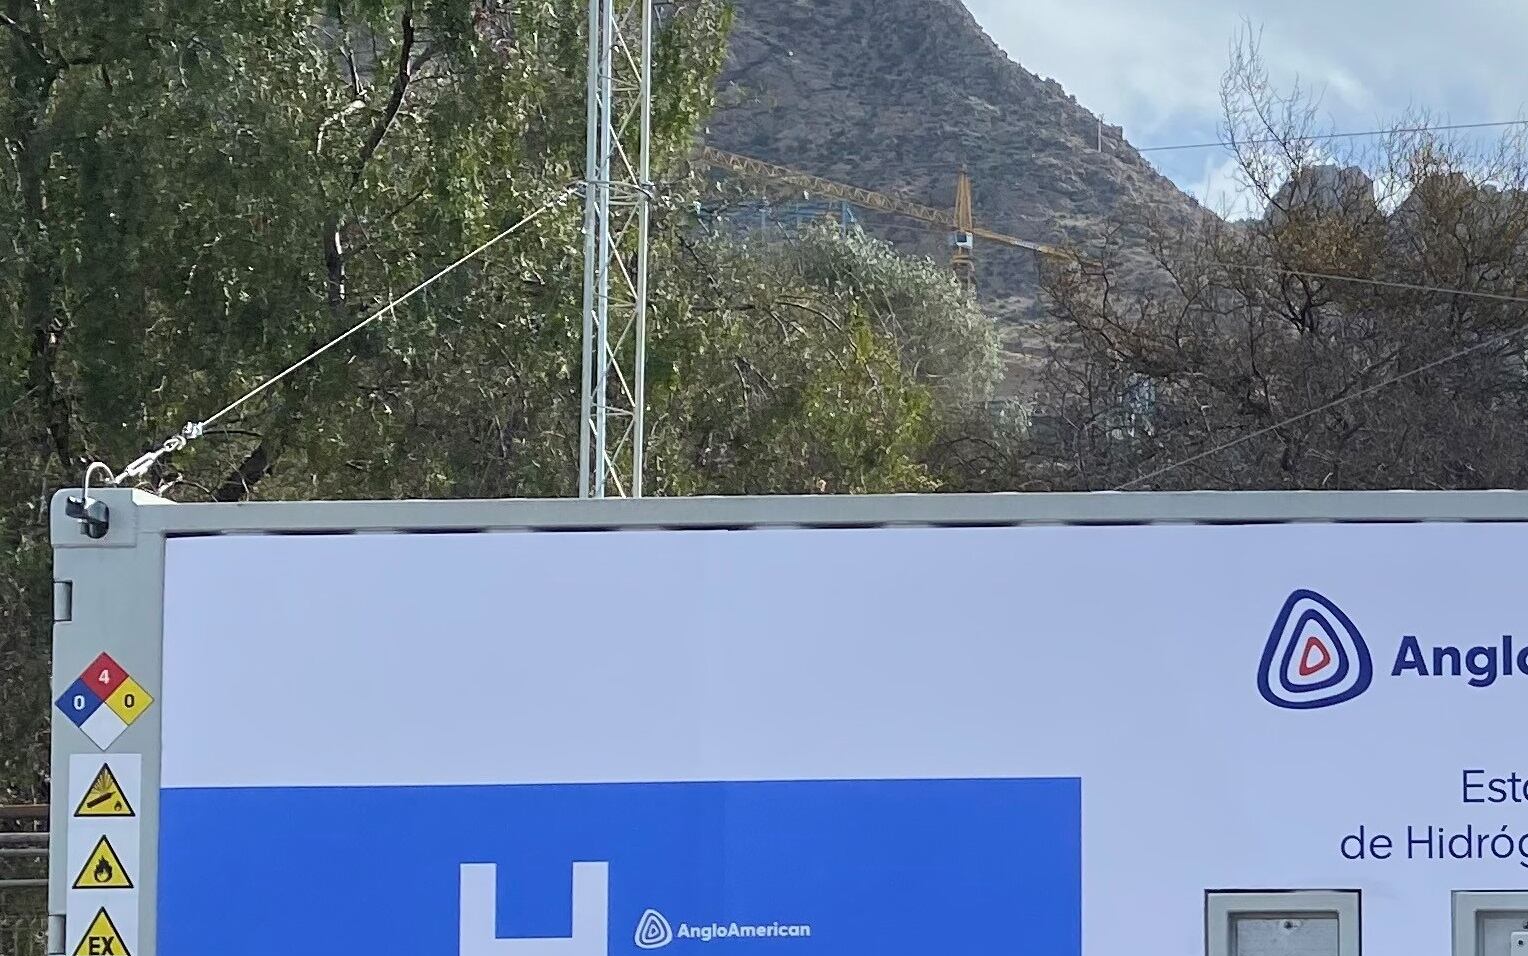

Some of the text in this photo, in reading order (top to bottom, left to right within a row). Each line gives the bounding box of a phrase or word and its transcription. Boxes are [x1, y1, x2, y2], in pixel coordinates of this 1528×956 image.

[98, 669, 110, 684] 4
[73, 694, 135, 710] 0 0
[1340, 825, 1393, 859] de
[677, 921, 811, 941] AngloAmerican
[89, 936, 114, 956] EX
